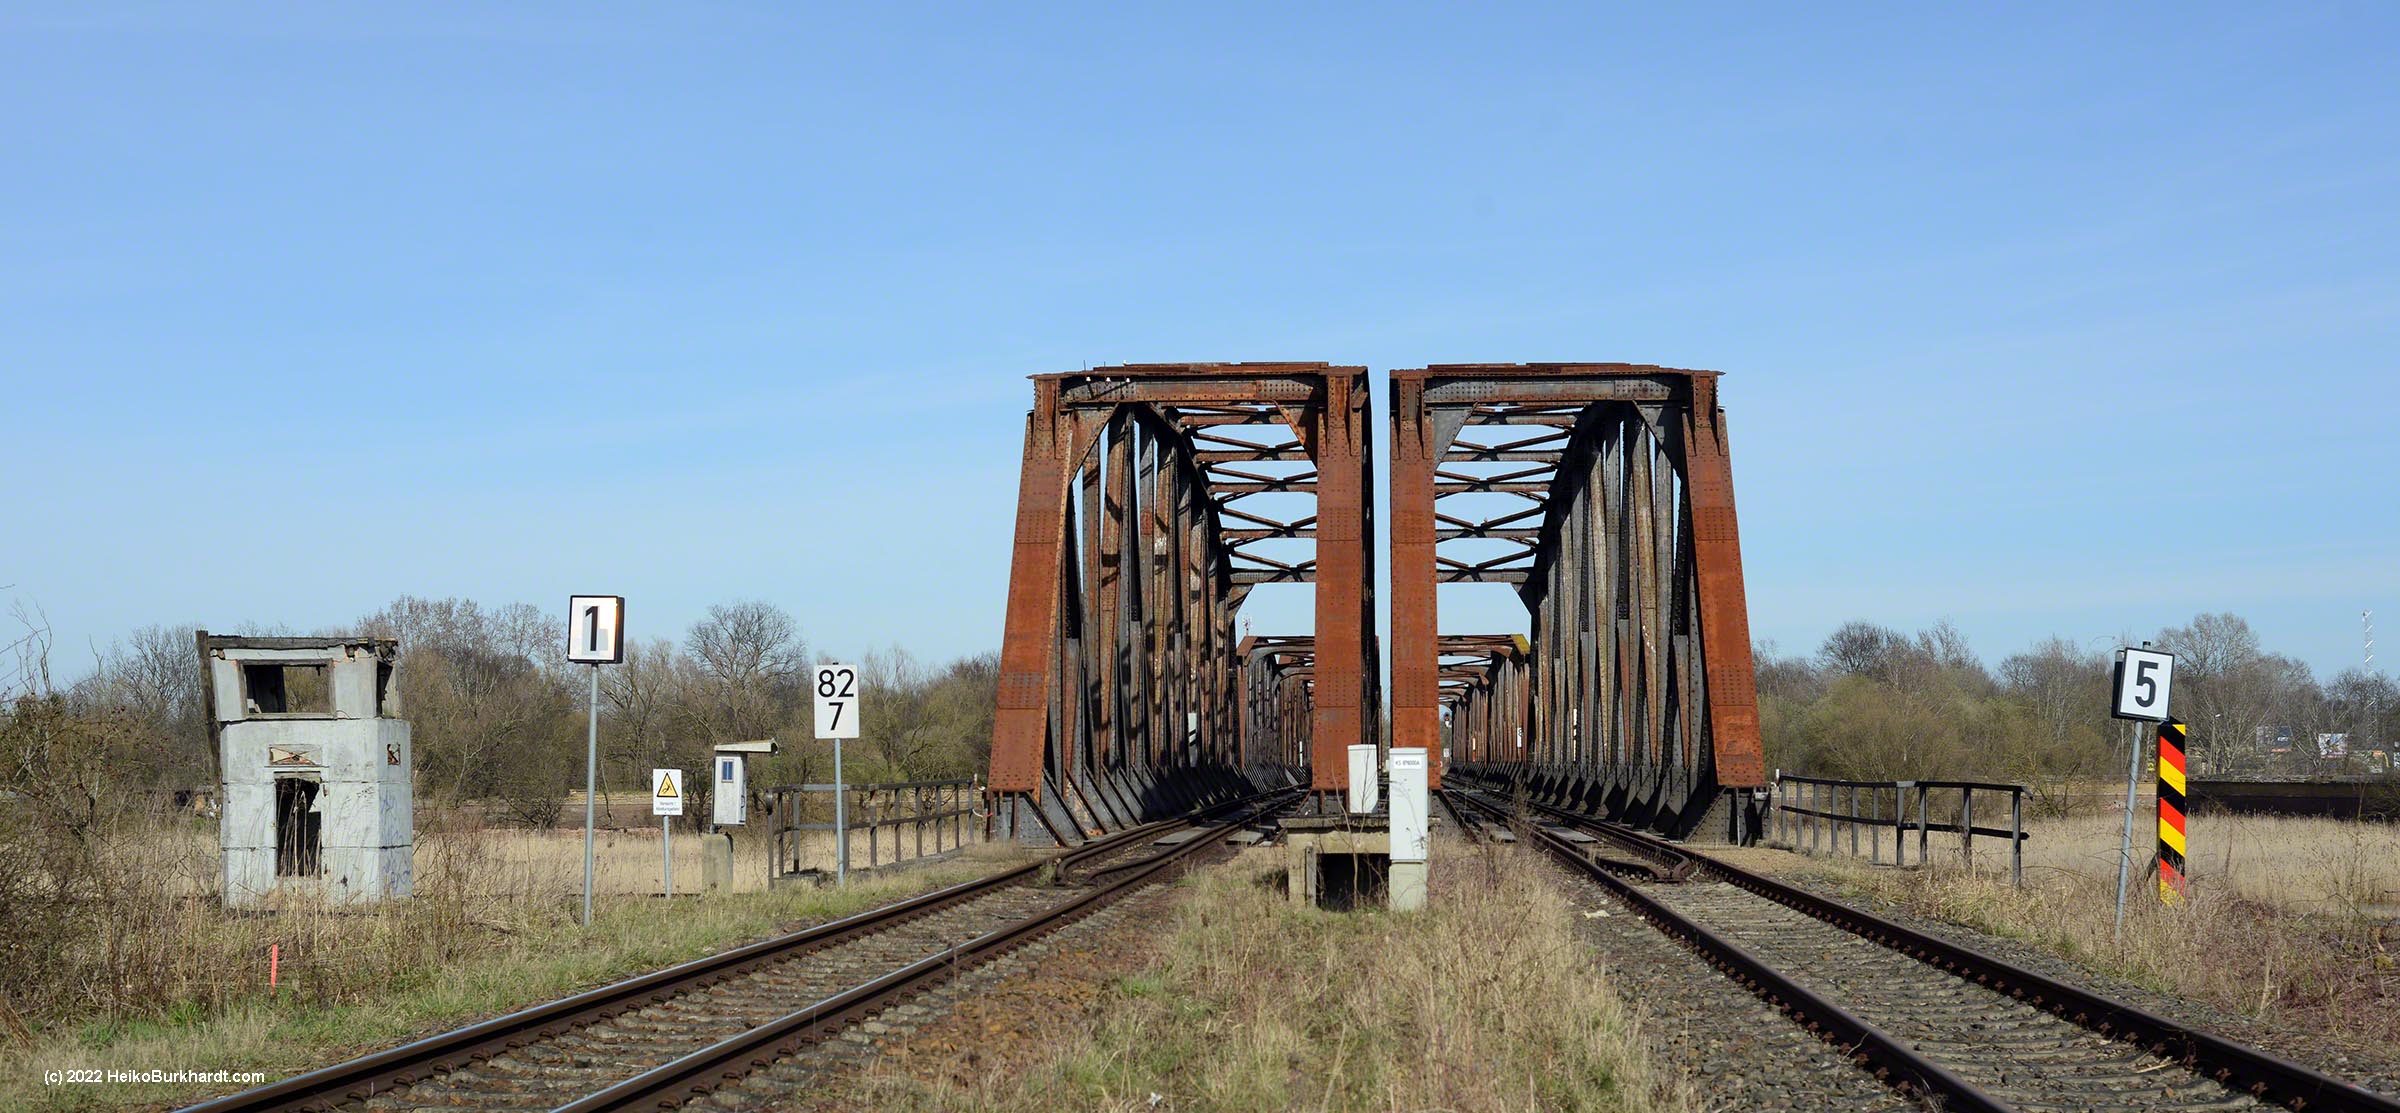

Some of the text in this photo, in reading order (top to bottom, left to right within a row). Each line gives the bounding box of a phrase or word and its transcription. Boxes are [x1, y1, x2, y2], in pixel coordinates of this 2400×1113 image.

[585, 605, 599, 652] 1
[817, 668, 855, 698] 82
[2135, 660, 2159, 708] 5
[828, 701, 844, 731] 7
